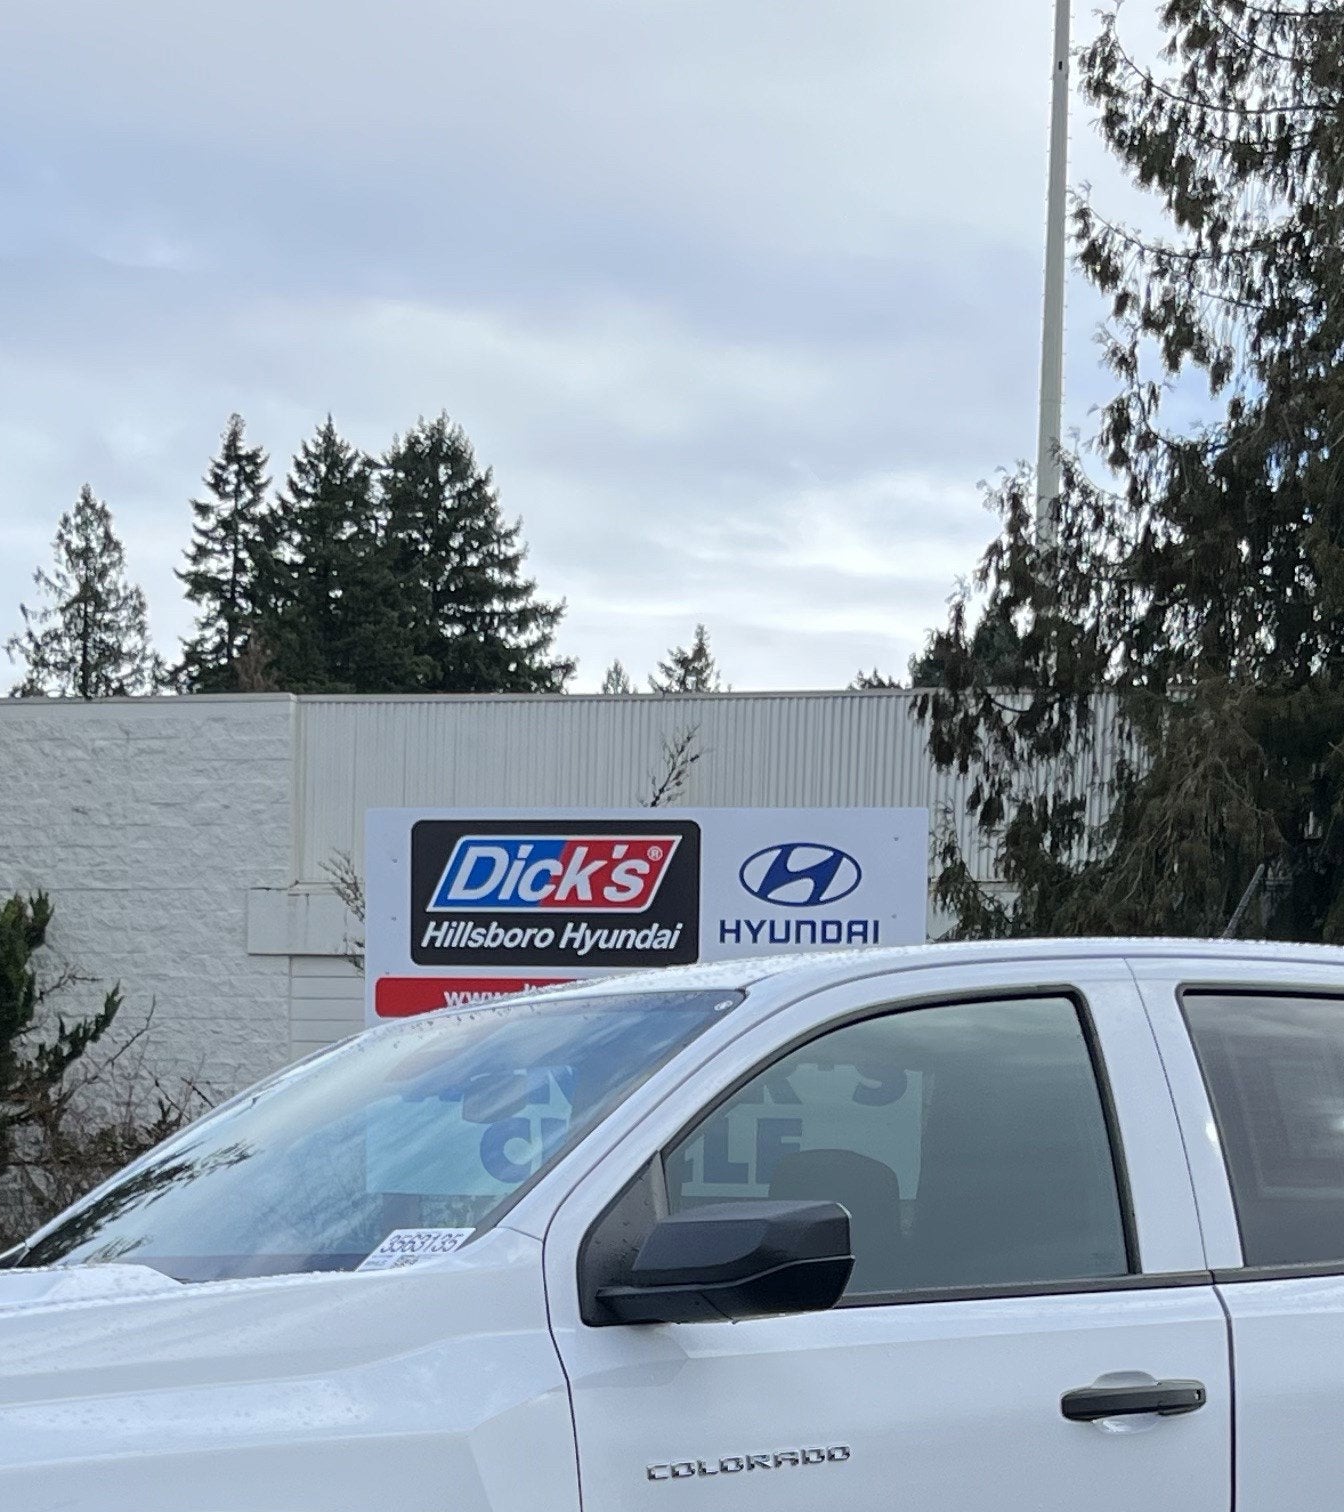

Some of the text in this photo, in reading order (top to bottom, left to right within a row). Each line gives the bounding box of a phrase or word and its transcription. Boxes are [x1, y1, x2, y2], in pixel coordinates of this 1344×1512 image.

[421, 921, 683, 955] Hillsboro Hyundai
[719, 919, 879, 945] HYUNDAI
[646, 1445, 851, 1481] COLORADO
